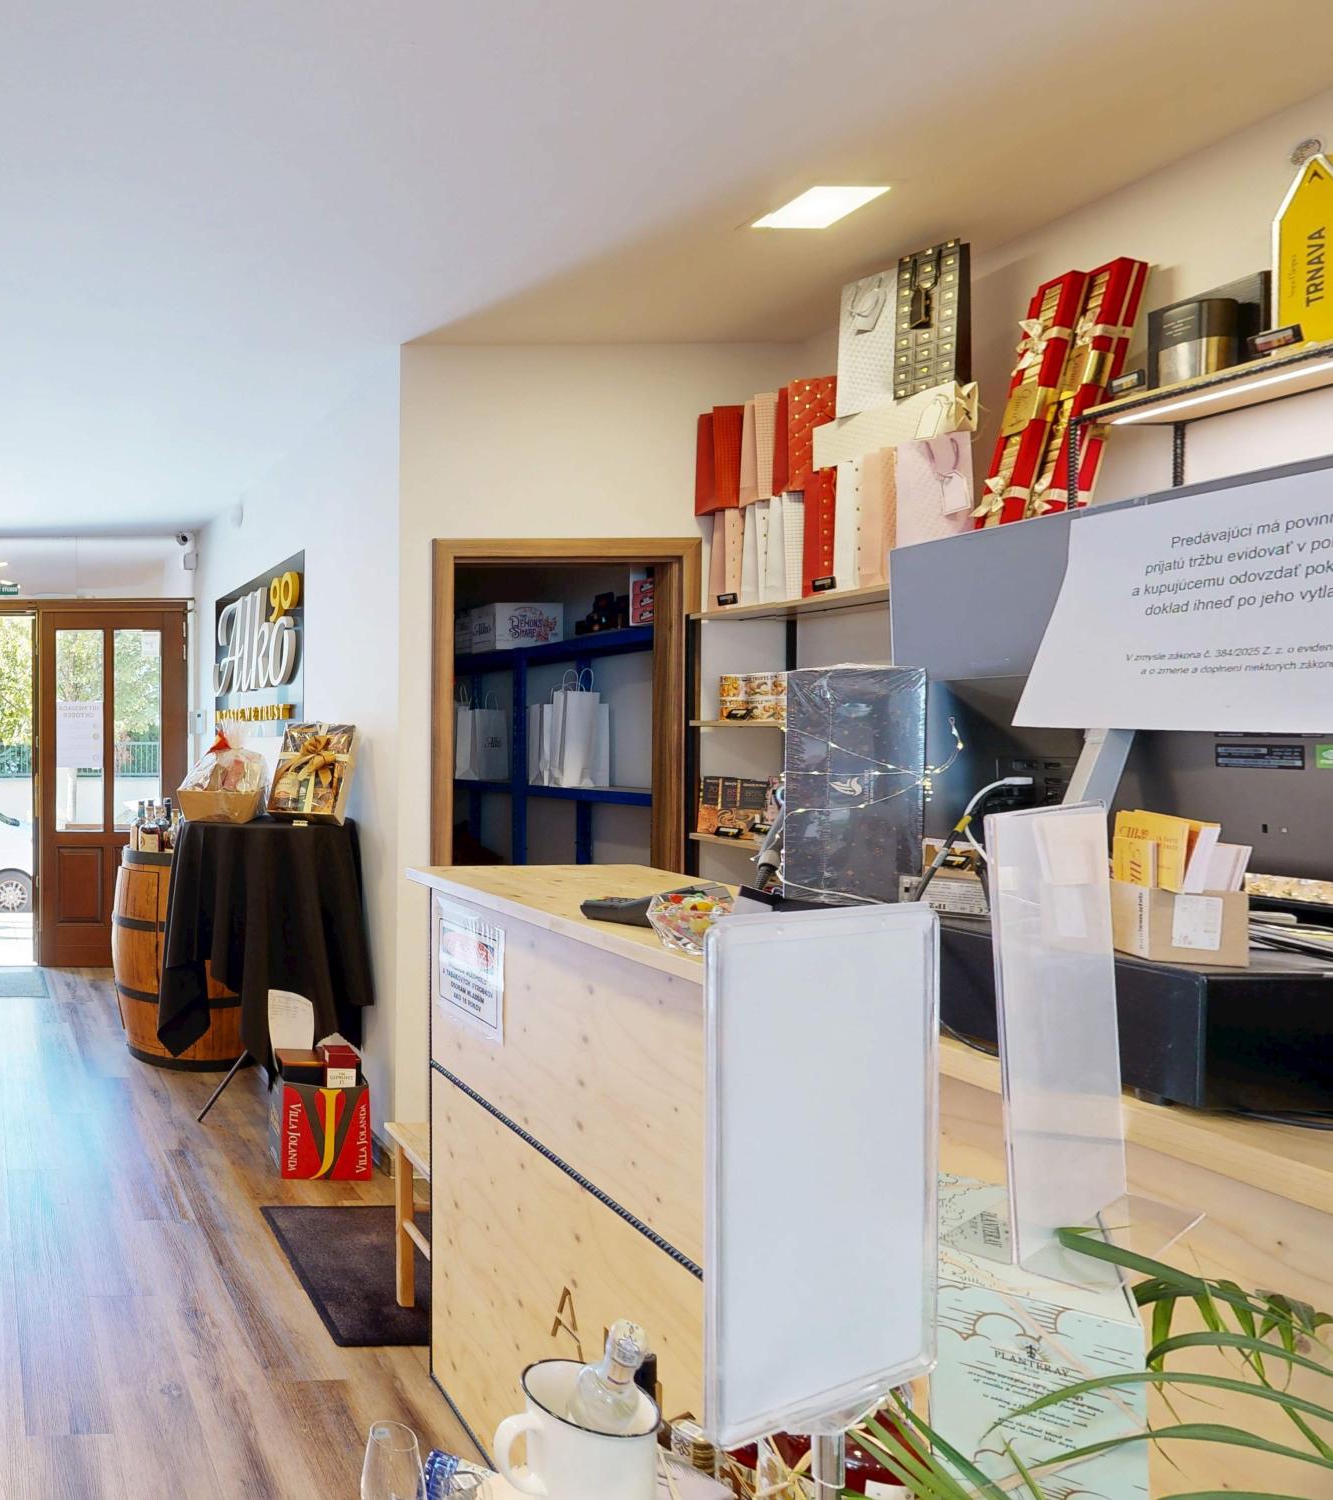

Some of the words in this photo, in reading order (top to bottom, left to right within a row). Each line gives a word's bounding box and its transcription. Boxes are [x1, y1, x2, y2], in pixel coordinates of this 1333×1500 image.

[1306, 227, 1327, 307] TRNAVA
[1171, 526, 1253, 548] Predávajúci
[1256, 519, 1280, 535] má
[1145, 556, 1185, 576] prijatú
[1189, 553, 1223, 568] tržbu
[1227, 541, 1293, 562] evidovať
[1297, 543, 1307, 553] v
[1131, 586, 1140, 597] a
[1144, 577, 1225, 596] kupujúcemu
[1229, 563, 1302, 585] odovzdať
[1145, 601, 1190, 616] doklad
[1193, 595, 1234, 612] ihneď
[1236, 594, 1257, 610] po
[1259, 590, 1295, 608] jeho
[288, 1103, 301, 1130] VILLA
[356, 1104, 368, 1147] JOLANDA
[287, 1131, 301, 1172] JOLANDA
[356, 1146, 368, 1174] VILLA
[994, 1350, 1069, 1377] PLANTERAY
